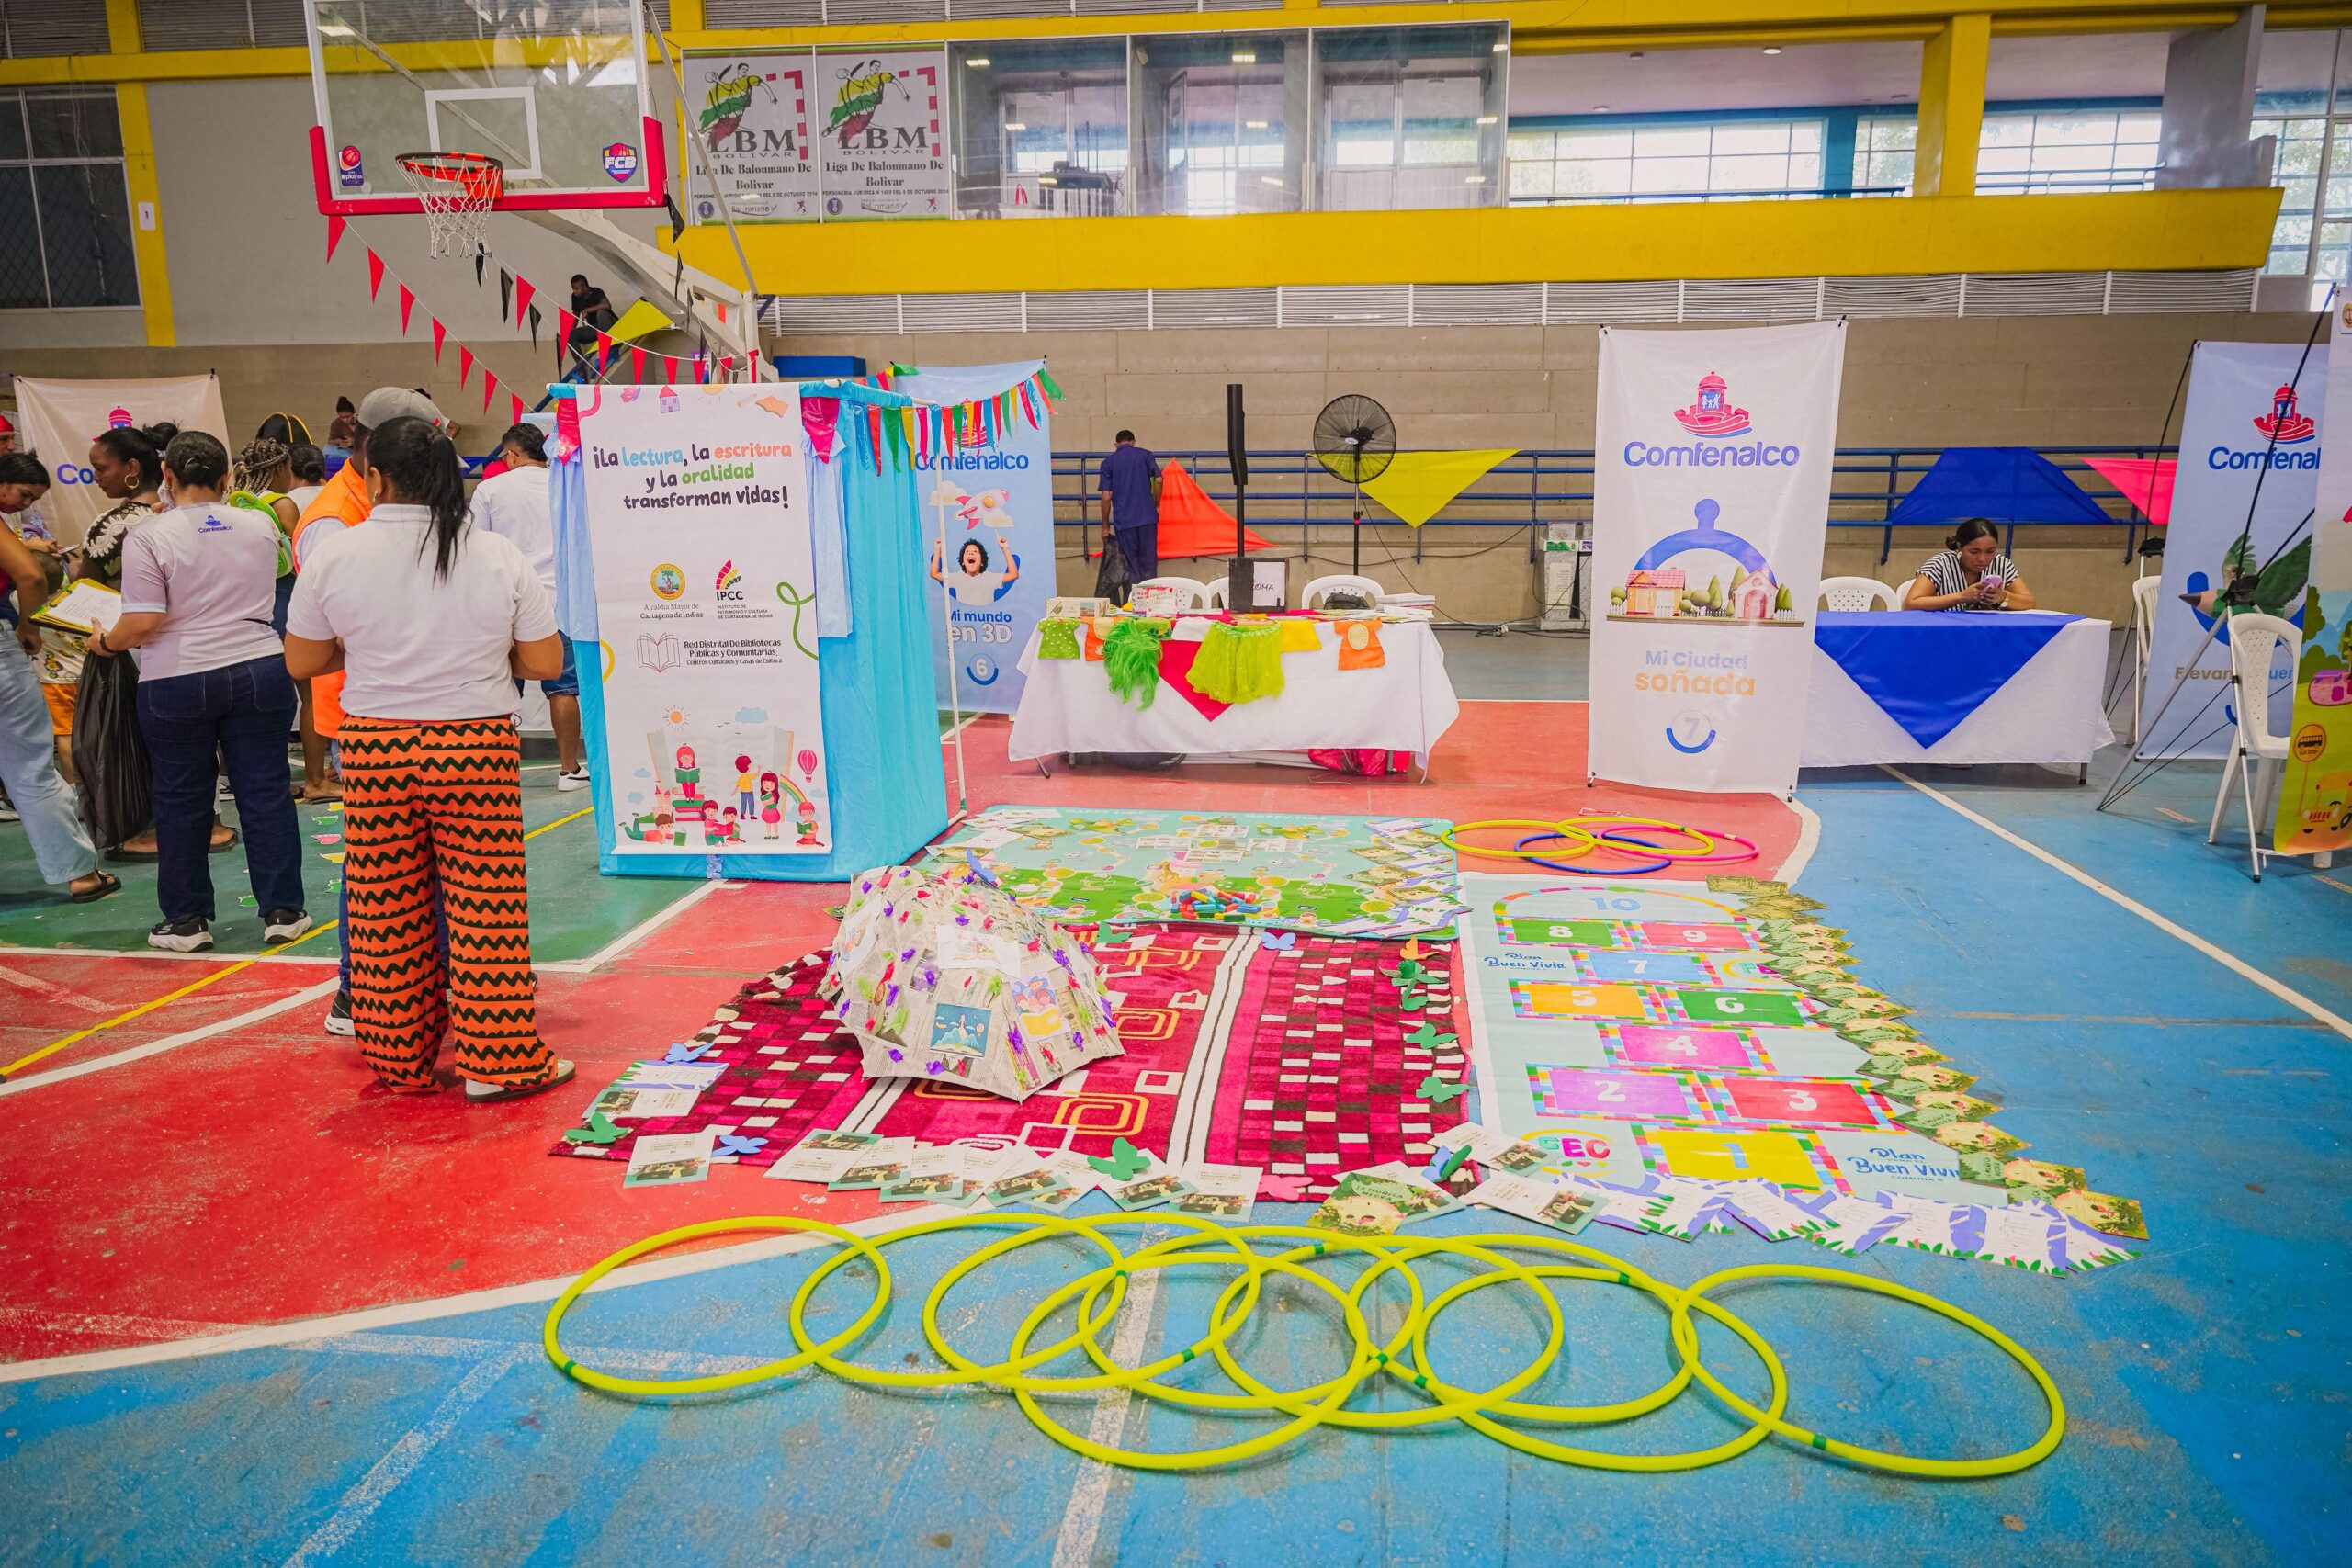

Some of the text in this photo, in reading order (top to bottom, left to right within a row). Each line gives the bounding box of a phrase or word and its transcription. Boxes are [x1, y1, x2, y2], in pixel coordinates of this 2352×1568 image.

[605, 156, 636, 169] FCB
[696, 163, 812, 175] Lia De Balonmano De
[826, 160, 944, 174] Liga De Balonmano De
[866, 176, 904, 187] Bolivar
[593, 442, 792, 469] ¡La lectura, la escritura
[1624, 441, 1801, 467] Comfenalco
[2208, 446, 2321, 470] Comfenal
[646, 462, 754, 493] y la oralidad
[624, 485, 789, 509] transforman vidas!
[198, 525, 233, 534] Comfenalco
[717, 591, 744, 601] IPCC
[671, 604, 690, 612] Mayor
[964, 611, 1012, 622] mundo
[952, 622, 1013, 643] en 3D
[684, 640, 698, 649] Red
[699, 639, 729, 649] Distrital
[741, 638, 781, 648] Bibliotecas
[690, 649, 719, 658] Públicas
[720, 650, 725, 659] y
[1645, 649, 1748, 670] Mi Ciudad
[976, 659, 989, 677] 6
[1634, 669, 1756, 696] soñada
[1684, 717, 1700, 740] 7
[1589, 897, 1641, 911] 10
[1548, 925, 1574, 938] 8
[1682, 930, 1708, 942] 9
[1484, 956, 1525, 967] Buen
[1628, 959, 1648, 974] 7
[1571, 989, 1597, 1007] 5
[1714, 996, 1746, 1014] 6
[1667, 1035, 1699, 1057] 4
[1594, 1079, 1627, 1102] 2
[1782, 1089, 1818, 1111] 3
[1721, 1142, 1750, 1169] 1
[1869, 1147, 1925, 1160] Plan
[1847, 1156, 1910, 1174] Buen
